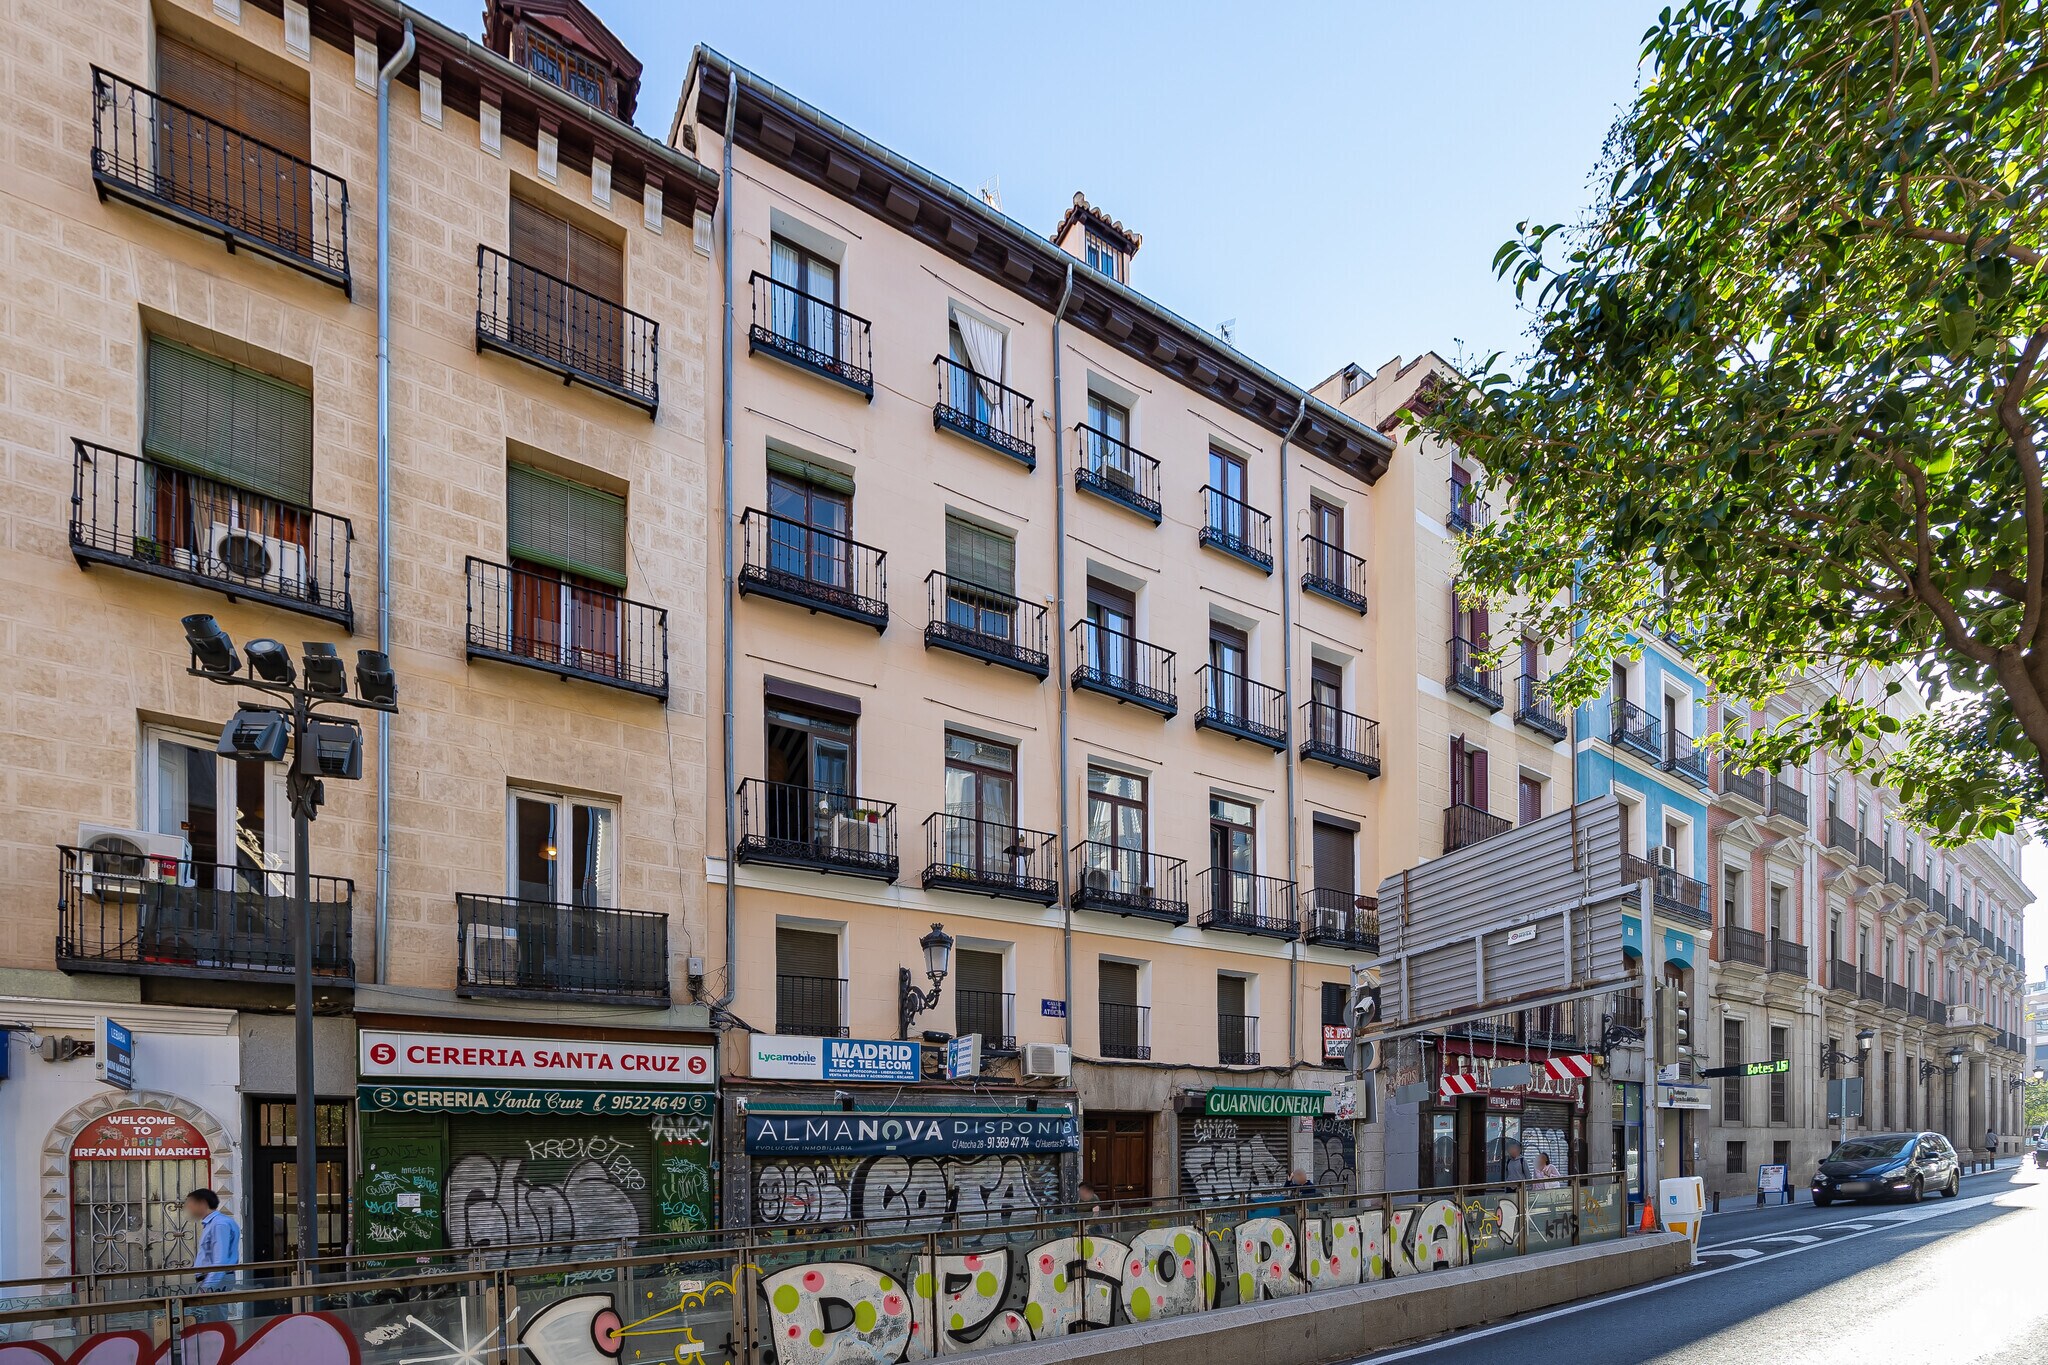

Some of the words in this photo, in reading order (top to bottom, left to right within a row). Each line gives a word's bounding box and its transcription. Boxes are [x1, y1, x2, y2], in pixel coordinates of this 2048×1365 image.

[1324, 1026, 1335, 1038] SE
[1336, 1027, 1352, 1038] VEND
[758, 1050, 816, 1063] Lycamobile
[831, 1042, 912, 1061] MADRID
[377, 1046, 390, 1061] 5
[407, 1045, 526, 1067] CERERIA
[533, 1050, 613, 1070] SANTA
[620, 1054, 680, 1072] CRUZ
[692, 1059, 703, 1071] 5
[831, 1059, 854, 1069] TEC
[858, 1060, 911, 1070] TELECOM
[403, 1091, 489, 1108] CERERIA
[493, 1090, 541, 1109] Santa
[544, 1092, 584, 1109] Cruz
[1210, 1093, 1321, 1114] GUARNICIONERIA
[107, 1116, 176, 1125] WELCOME
[133, 1126, 152, 1135] TO
[757, 1119, 943, 1141] ALMANOVA
[74, 1148, 117, 1157] IRFAN
[120, 1148, 151, 1156] MINI
[154, 1147, 208, 1156] MARKET
